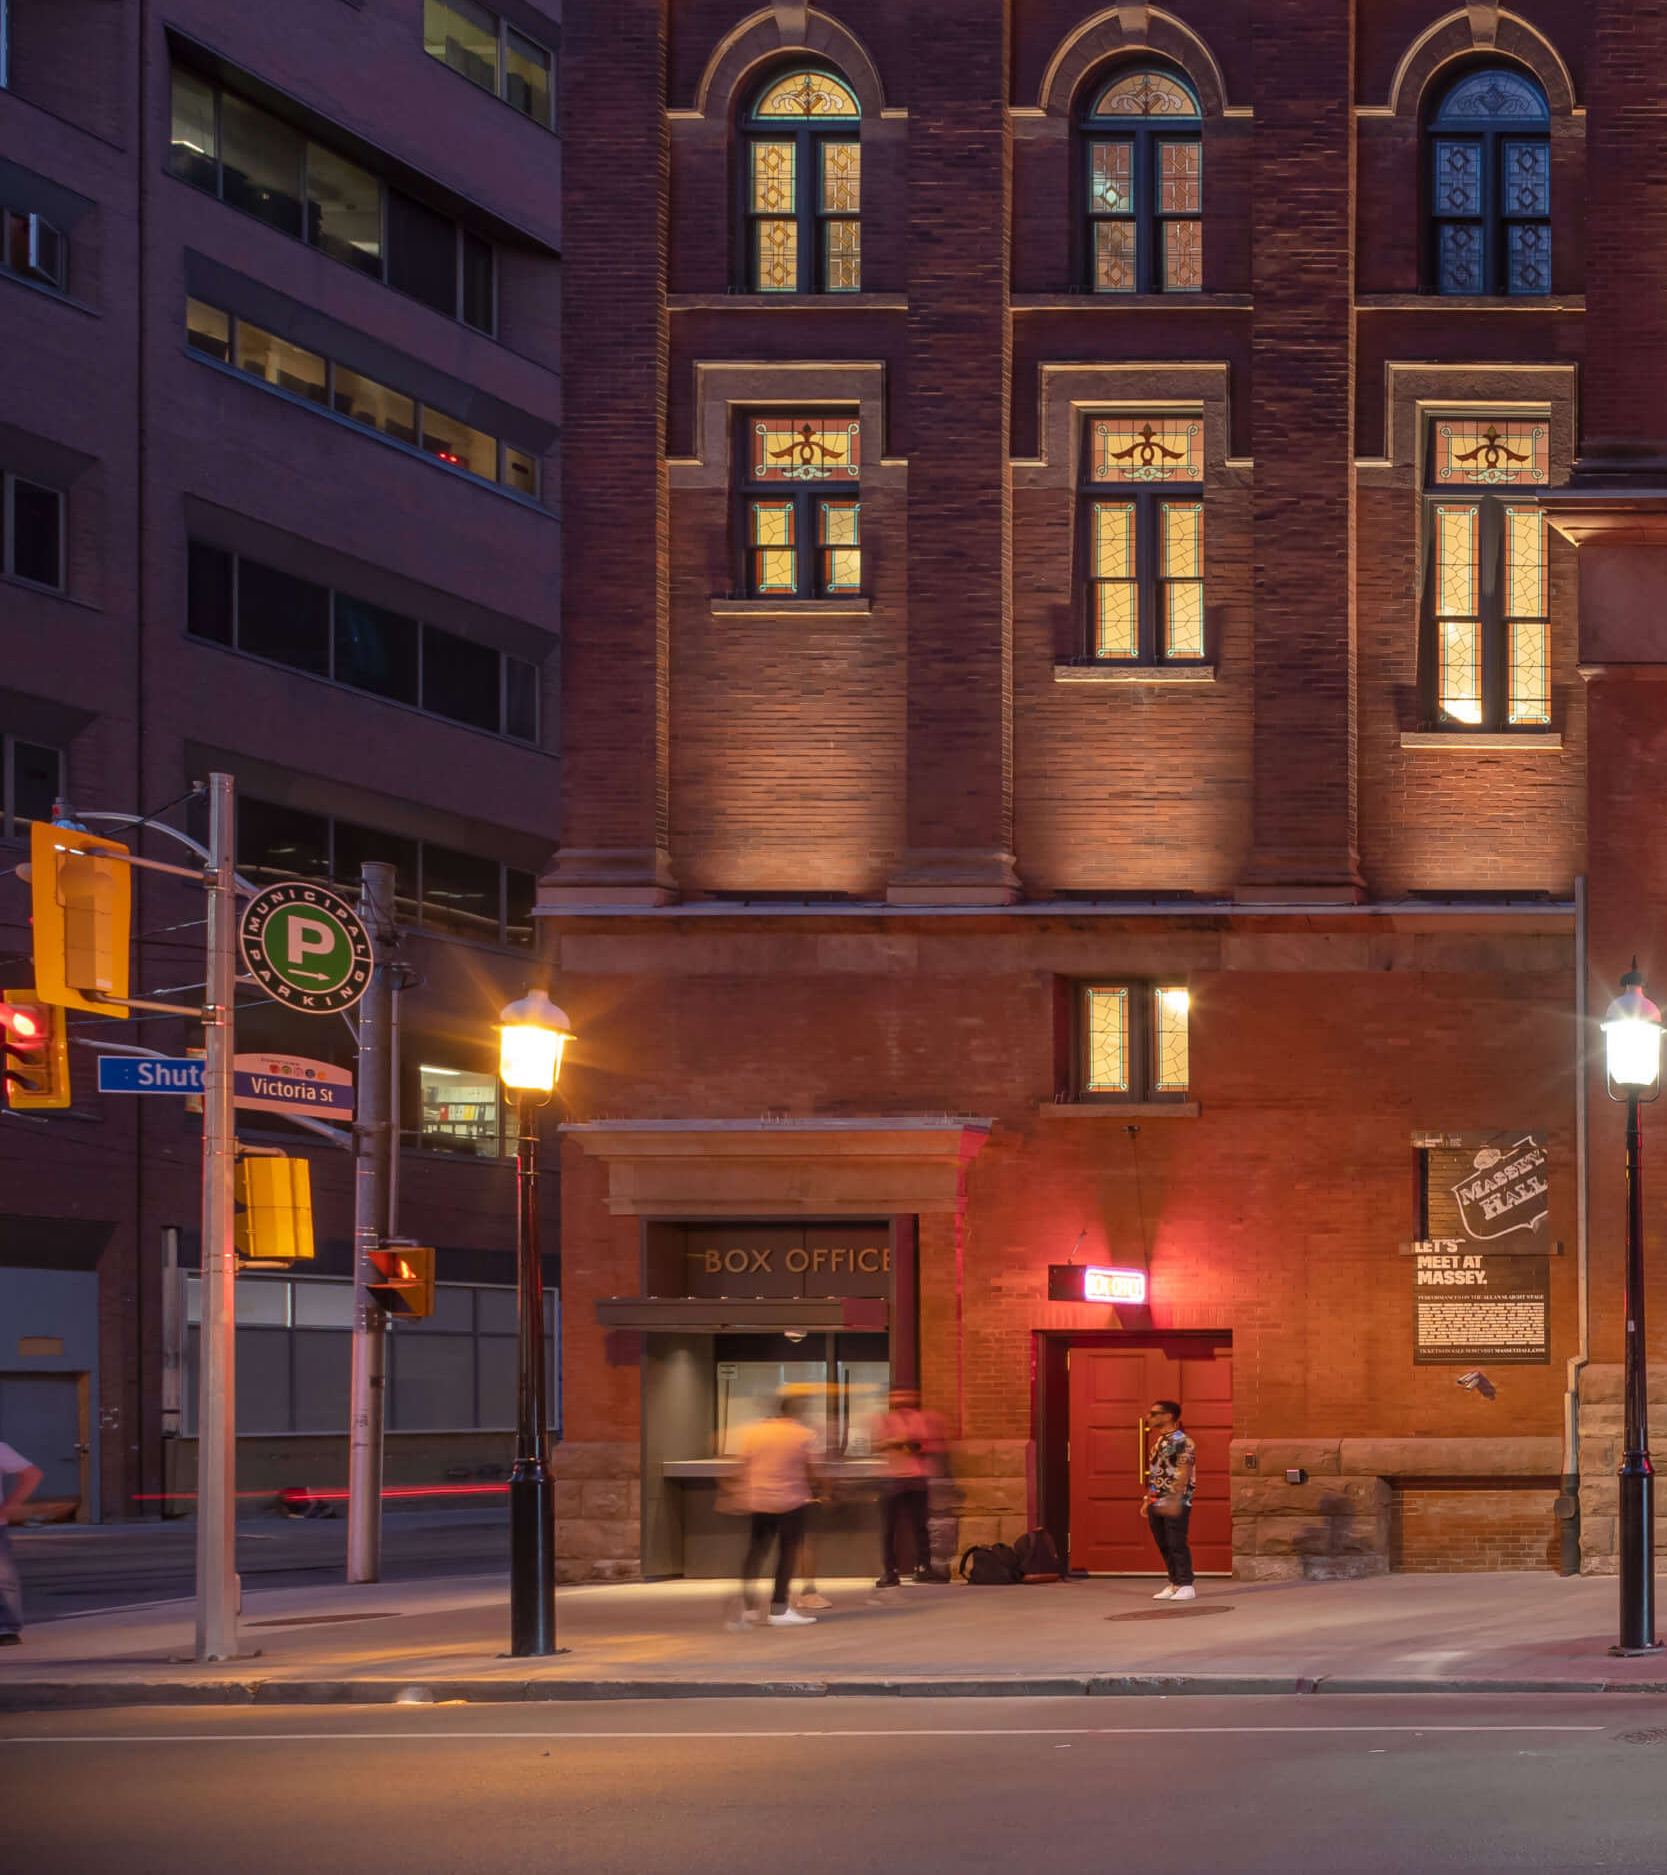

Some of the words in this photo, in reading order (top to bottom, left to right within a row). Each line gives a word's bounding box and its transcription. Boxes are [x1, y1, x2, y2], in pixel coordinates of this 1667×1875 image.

[248, 889, 366, 954] MUNICIPAL
[287, 915, 336, 965] P
[249, 948, 366, 1006] PARKING
[251, 1076, 316, 1101] Victoria
[320, 1084, 334, 1103] St
[1459, 1148, 1545, 1205] MASSEY
[1479, 1176, 1548, 1221] HALL
[704, 1248, 773, 1274] BOX
[1415, 1239, 1464, 1253] LET'S
[1417, 1255, 1460, 1269] MEET
[1462, 1255, 1483, 1269] AT
[1417, 1270, 1488, 1285] MASSEY.
